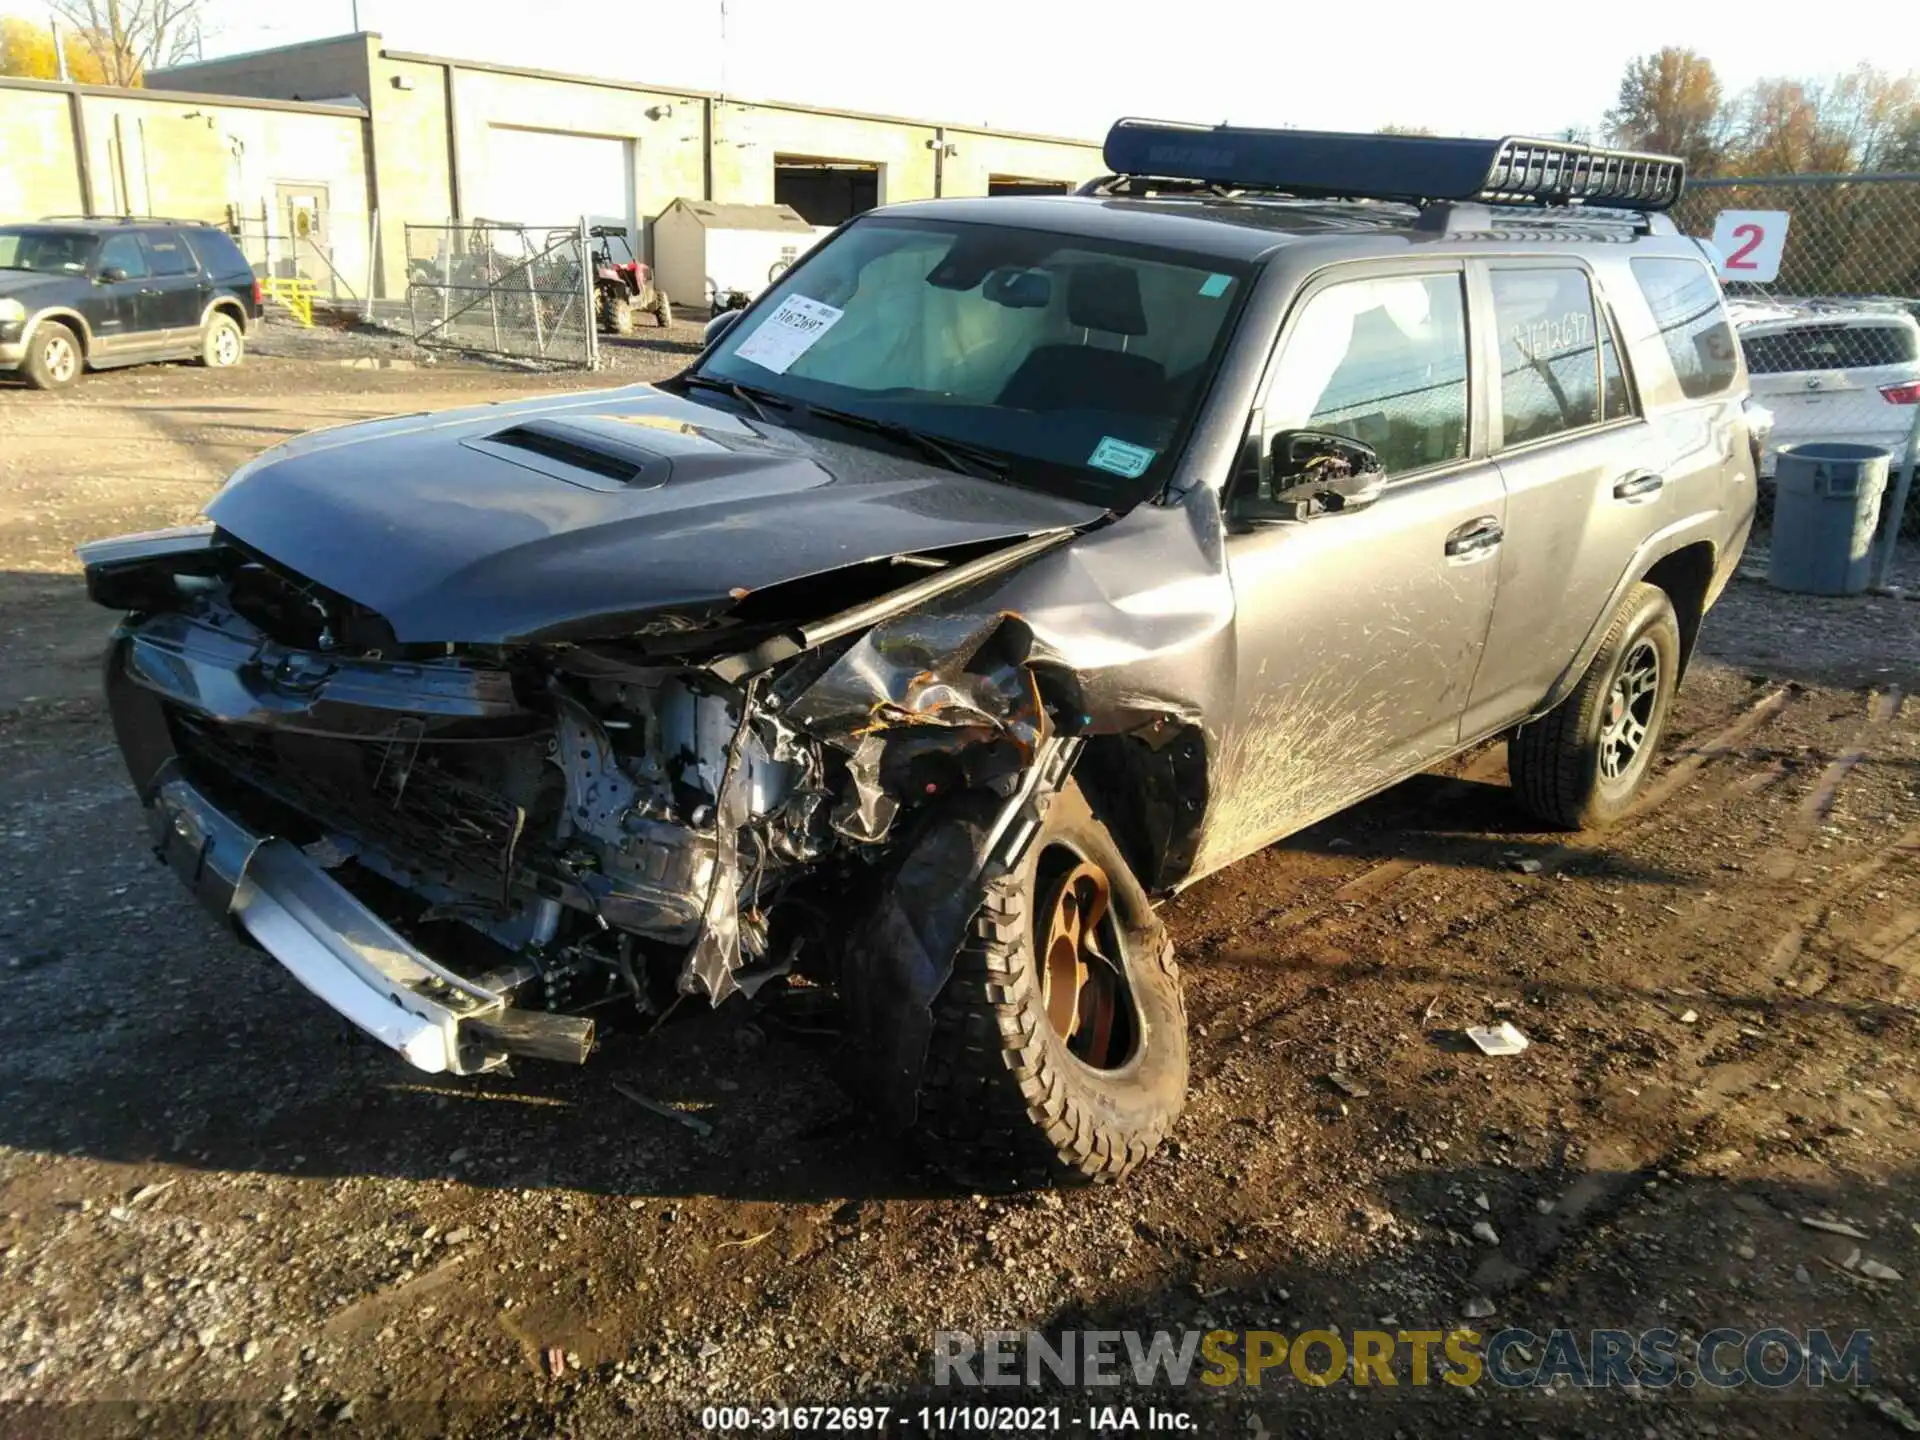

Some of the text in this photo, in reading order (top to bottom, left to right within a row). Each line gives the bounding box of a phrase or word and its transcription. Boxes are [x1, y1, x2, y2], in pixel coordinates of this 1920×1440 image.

[1726, 224, 1765, 269] 2
[776, 308, 823, 334] 31672697
[1511, 311, 1590, 369] 31672697
